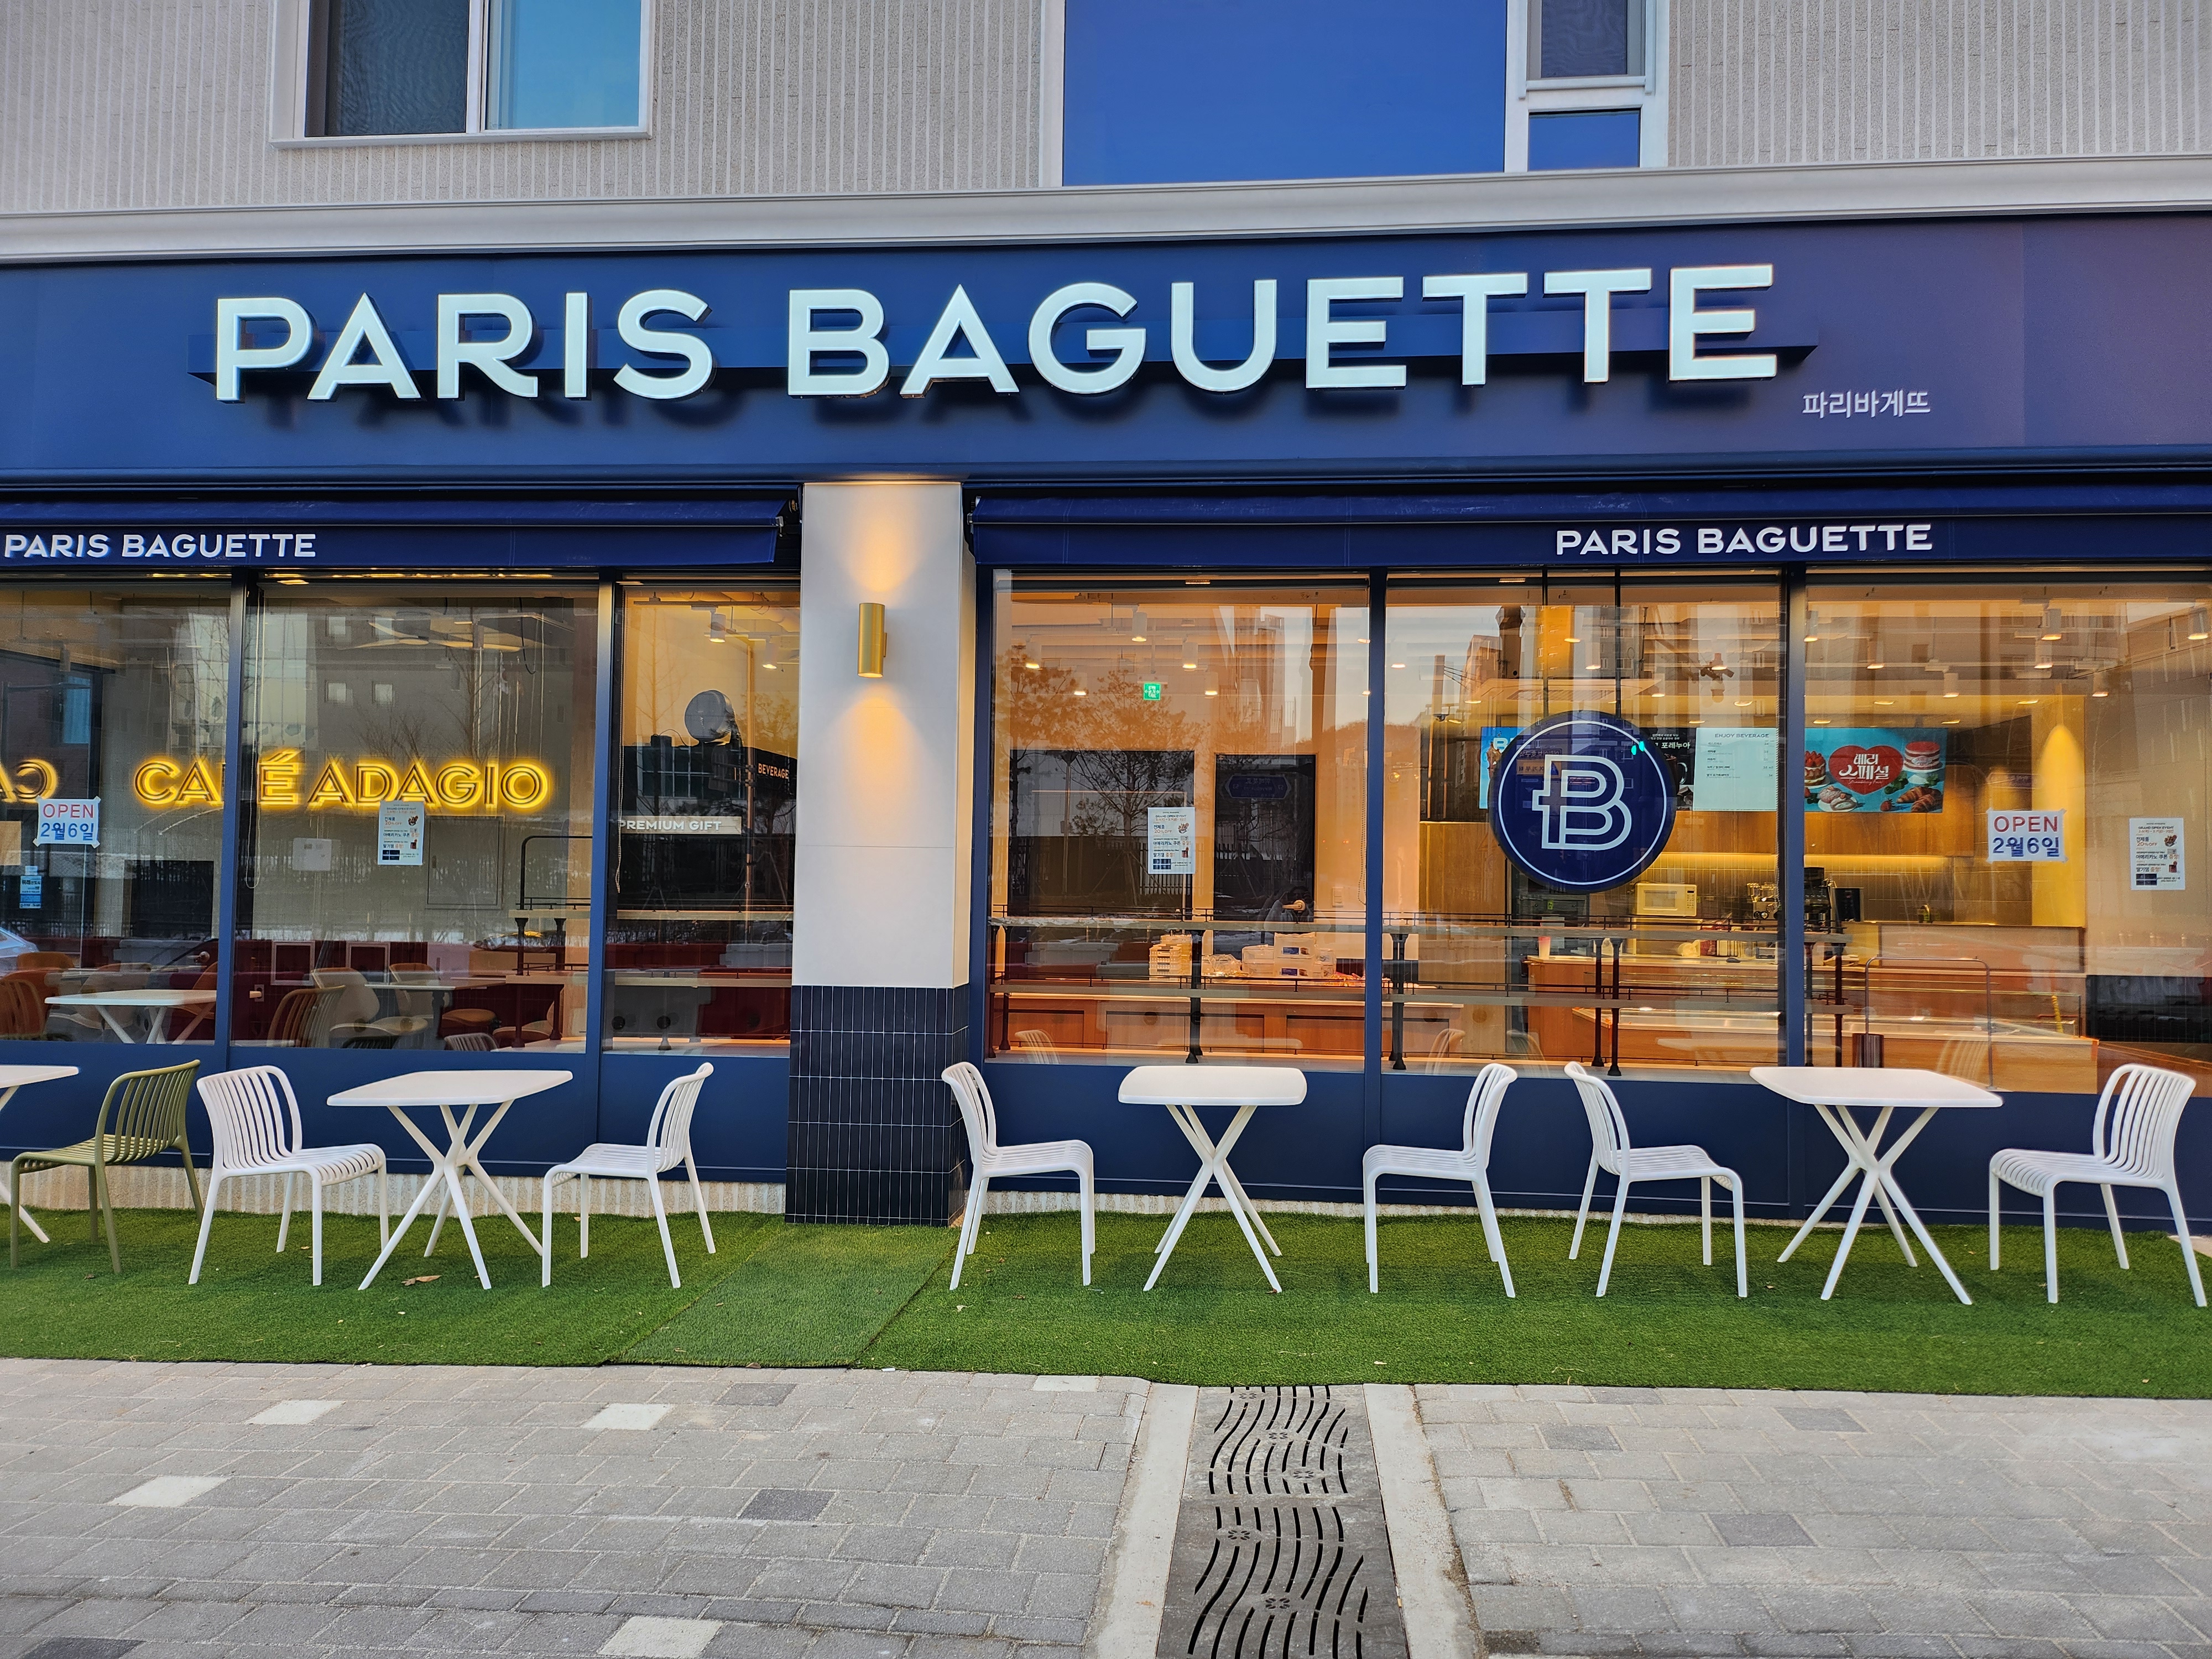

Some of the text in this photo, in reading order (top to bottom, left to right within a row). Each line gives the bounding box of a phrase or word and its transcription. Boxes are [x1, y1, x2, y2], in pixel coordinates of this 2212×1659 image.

[216, 263, 1777, 401] PARIS BAGUETTE
[1802, 388, 1931, 419] 파리바게뜨
[4, 534, 316, 558] PARIS BAGUETTE
[1557, 524, 1933, 555] PARIS BAGUETTE
[1853, 753, 1879, 765] 베리
[134, 750, 549, 808] CAÉ ADAGIO
[758, 763, 789, 780] BEVERAGE
[1839, 764, 1890, 780] 스페셜
[43, 804, 94, 818] OPEN
[41, 822, 94, 841] 2월6일
[619, 820, 722, 831] PREMIUM GIFT
[1994, 816, 2058, 832] OPEN
[1992, 837, 2060, 857] 2월6일
